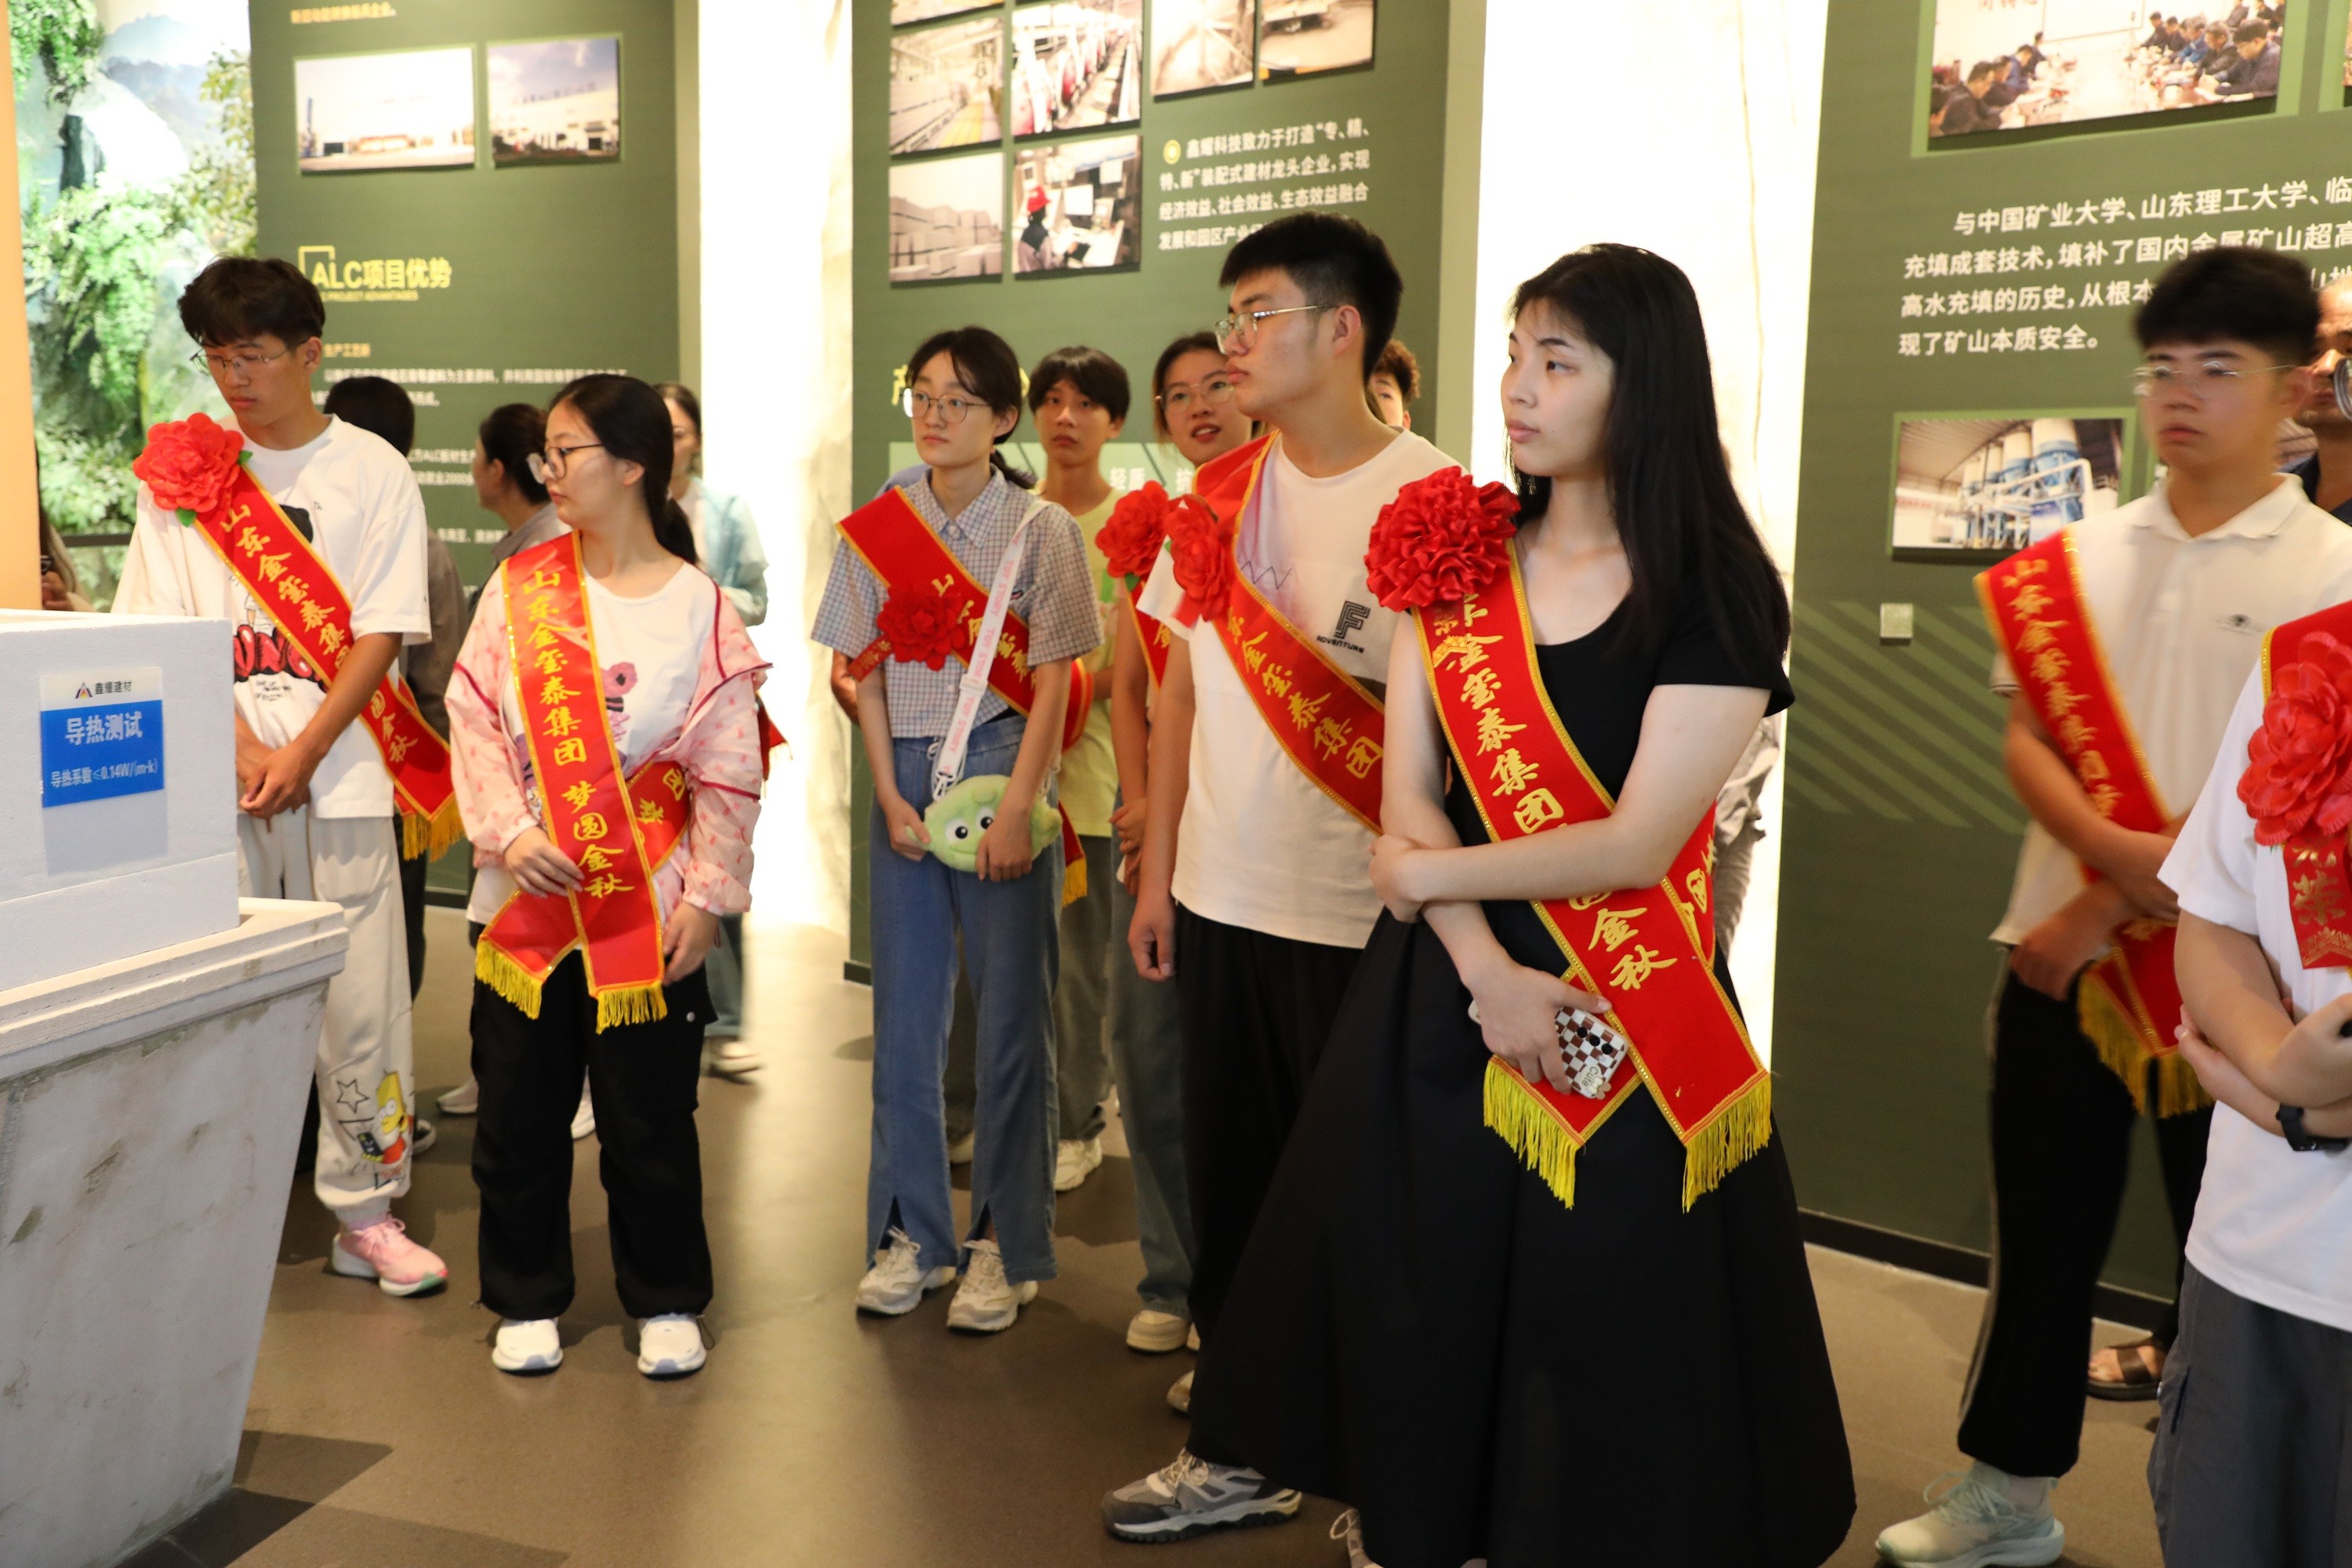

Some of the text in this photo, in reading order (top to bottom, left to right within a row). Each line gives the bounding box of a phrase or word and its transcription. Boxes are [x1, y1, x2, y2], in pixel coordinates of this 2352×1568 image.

[312, 256, 452, 289] ALC项目优势
[1898, 323, 2099, 356] 现了矿山本质安全。
[65, 710, 143, 746] 导热测试
